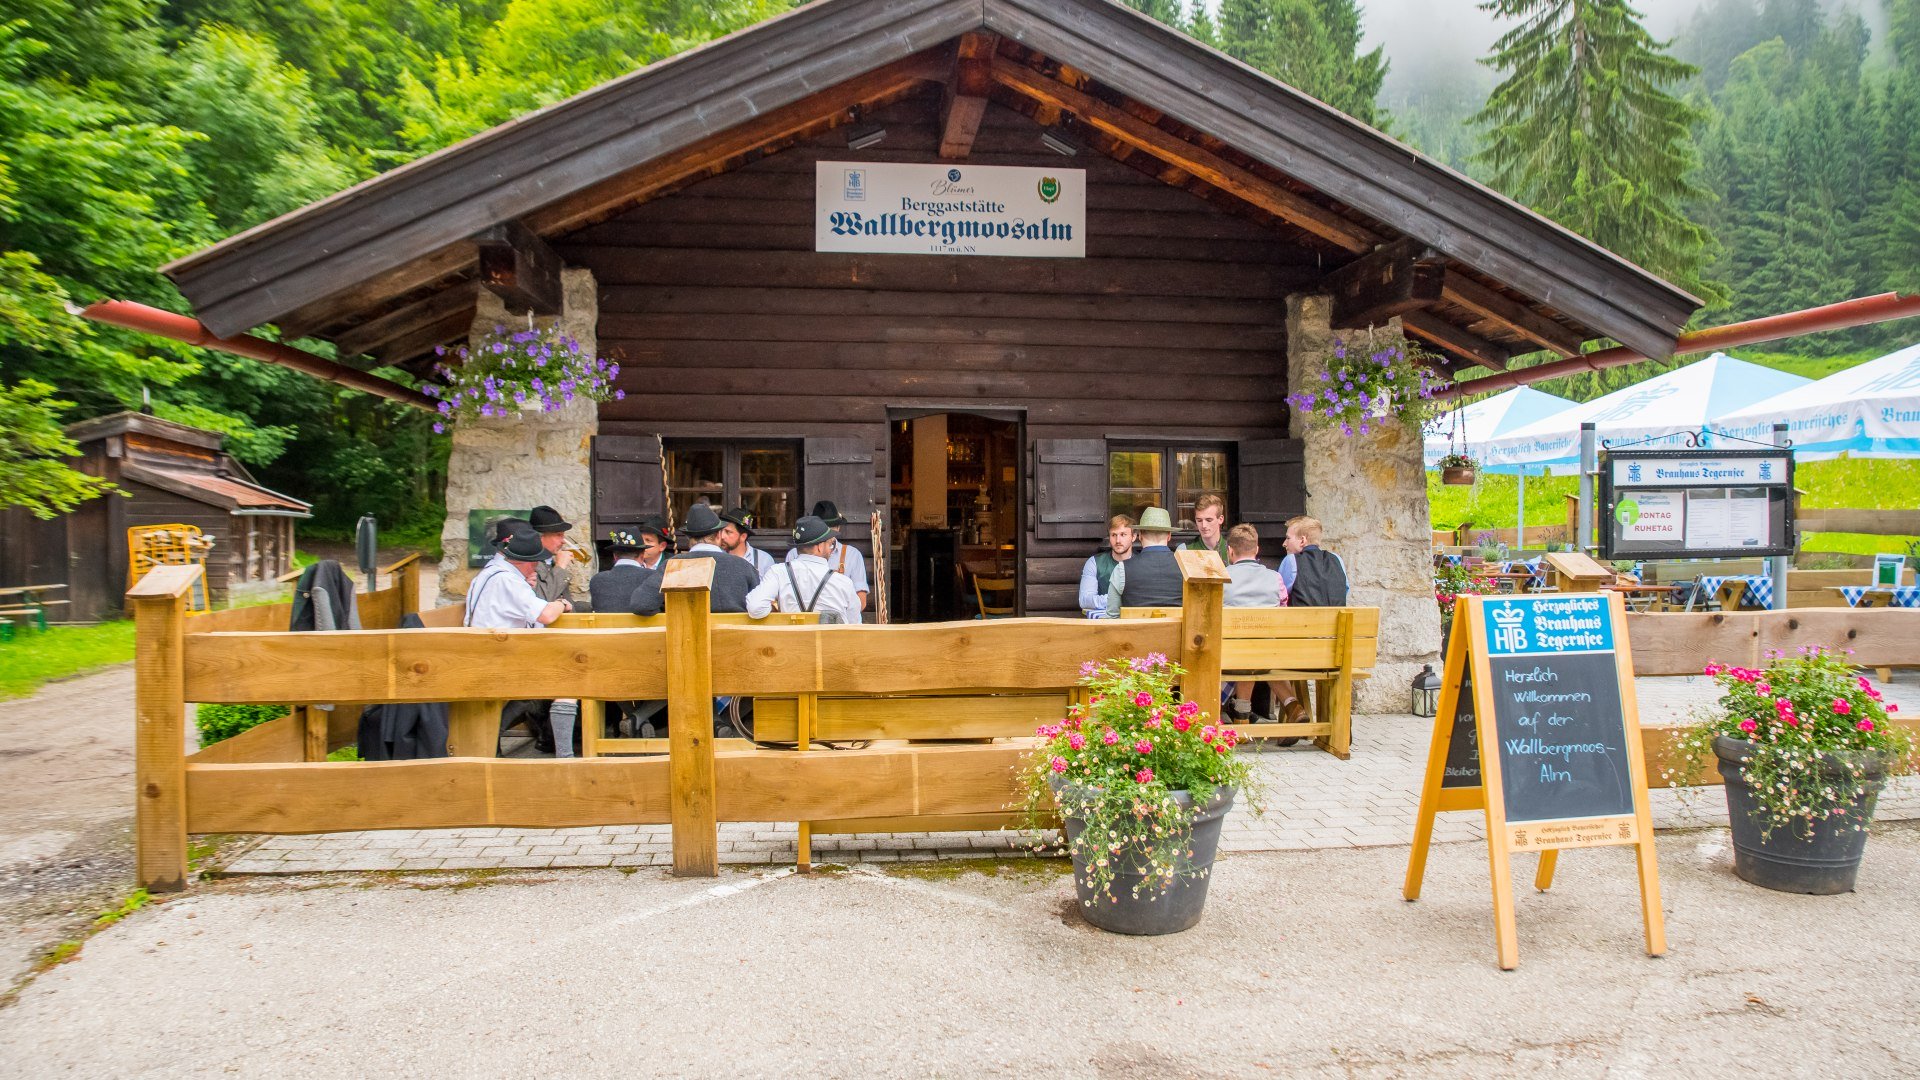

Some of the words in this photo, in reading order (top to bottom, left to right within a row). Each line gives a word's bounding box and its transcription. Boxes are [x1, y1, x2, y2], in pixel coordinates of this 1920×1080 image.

[931, 180, 974, 196] Blümer
[901, 197, 1005, 216] Berggaststätte
[830, 211, 1073, 245] Wallbergmoosalm
[1656, 468, 1700, 479] Brauhaus
[1702, 467, 1745, 480] Tegernsee
[1532, 598, 1600, 615] Herzogliches
[1533, 614, 1602, 633] Brauhaus
[1535, 631, 1604, 651] Tegernsee
[1505, 666, 1558, 683] Herzlich
[1513, 690, 1591, 703] Willkommen
[1518, 711, 1541, 734] auf
[1547, 712, 1574, 727] der
[1540, 763, 1571, 783] Alm
